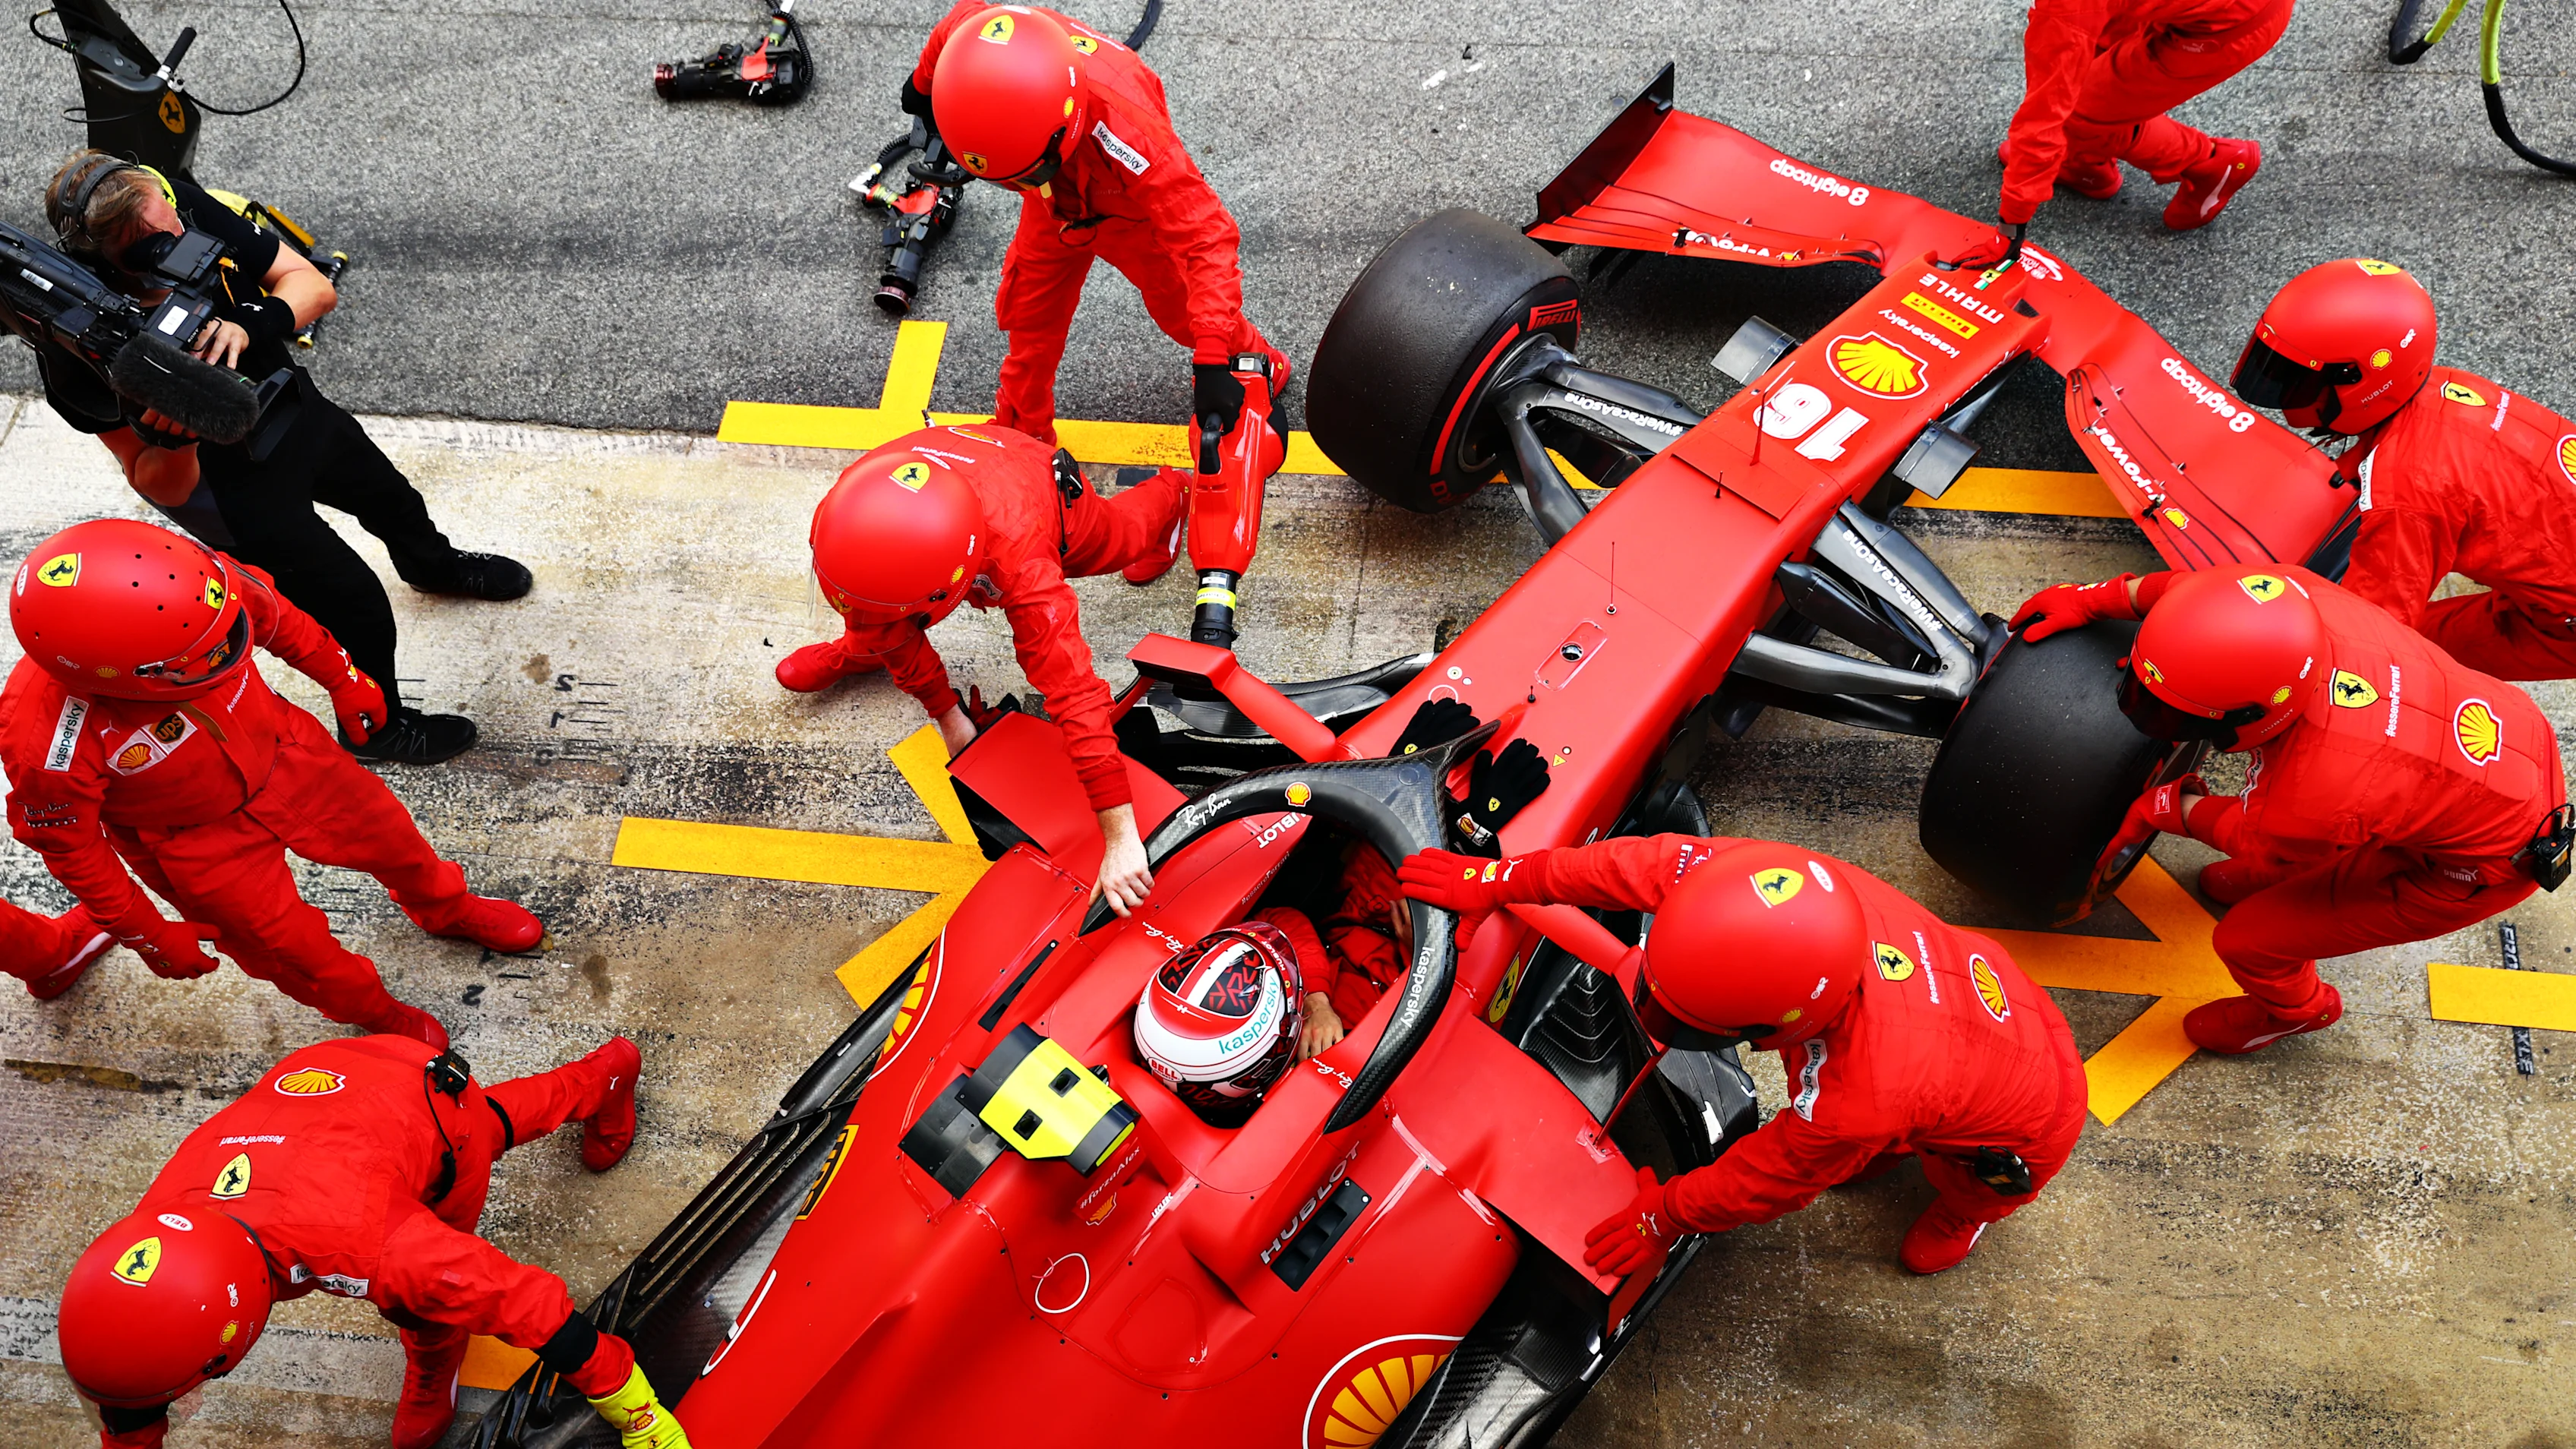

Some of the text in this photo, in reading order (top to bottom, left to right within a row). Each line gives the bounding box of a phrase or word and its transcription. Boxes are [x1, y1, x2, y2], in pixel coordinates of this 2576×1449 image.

[1097, 127, 1142, 170] kaspersky
[1526, 292, 1577, 333] PIRELLI
[1919, 273, 2004, 324] MAHLE
[1878, 309, 1960, 359] kaspersky
[1564, 392, 1684, 437] #WeRaceAsOne
[2361, 380, 2394, 404] HUBLOT
[1753, 382, 1870, 462] 16
[1842, 529, 1943, 631] #WeRaceAsOne
[2385, 664, 2400, 737] #essereFerrari
[51, 702, 84, 768] kaspersky
[156, 714, 183, 740] ups
[1261, 940, 1286, 971] HUBLOT
[1912, 930, 1940, 1005] #essereFerrari
[1400, 946, 1436, 1029] kaspersky
[1218, 976, 1280, 1055] kaspersky
[1151, 1059, 1178, 1080] BELL
[1795, 1043, 1821, 1113] kaspersky
[2516, 1030, 2534, 1075] XLE
[1080, 1146, 1140, 1208] #forzaAlex
[1261, 1141, 1361, 1264] HUBLOT
[163, 1216, 188, 1228] BELL
